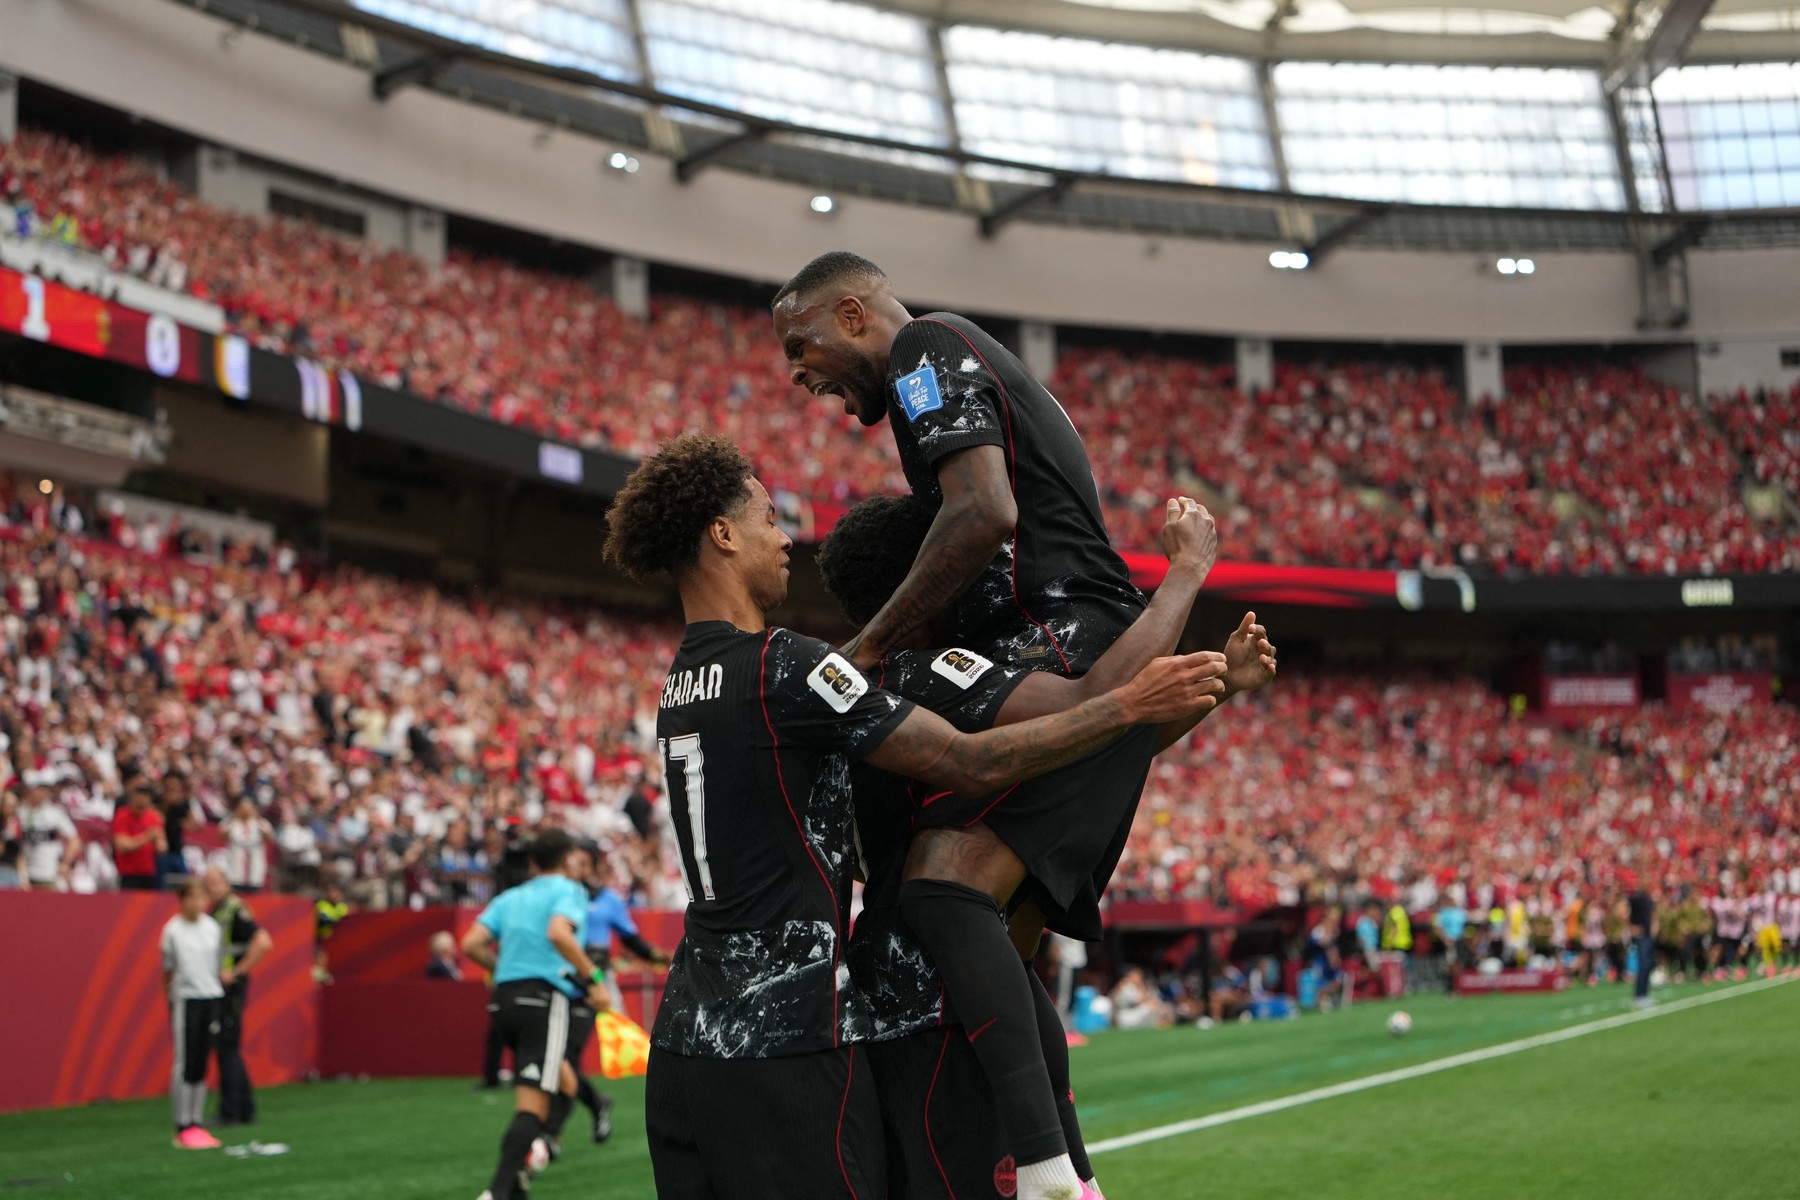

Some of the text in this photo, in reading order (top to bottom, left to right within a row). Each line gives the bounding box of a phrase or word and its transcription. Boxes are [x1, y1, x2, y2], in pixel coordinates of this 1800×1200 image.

[21, 275, 50, 342] 1
[145, 314, 181, 378] 0
[911, 393, 929, 408] PEACE
[996, 1172, 1016, 1181] CANAD
